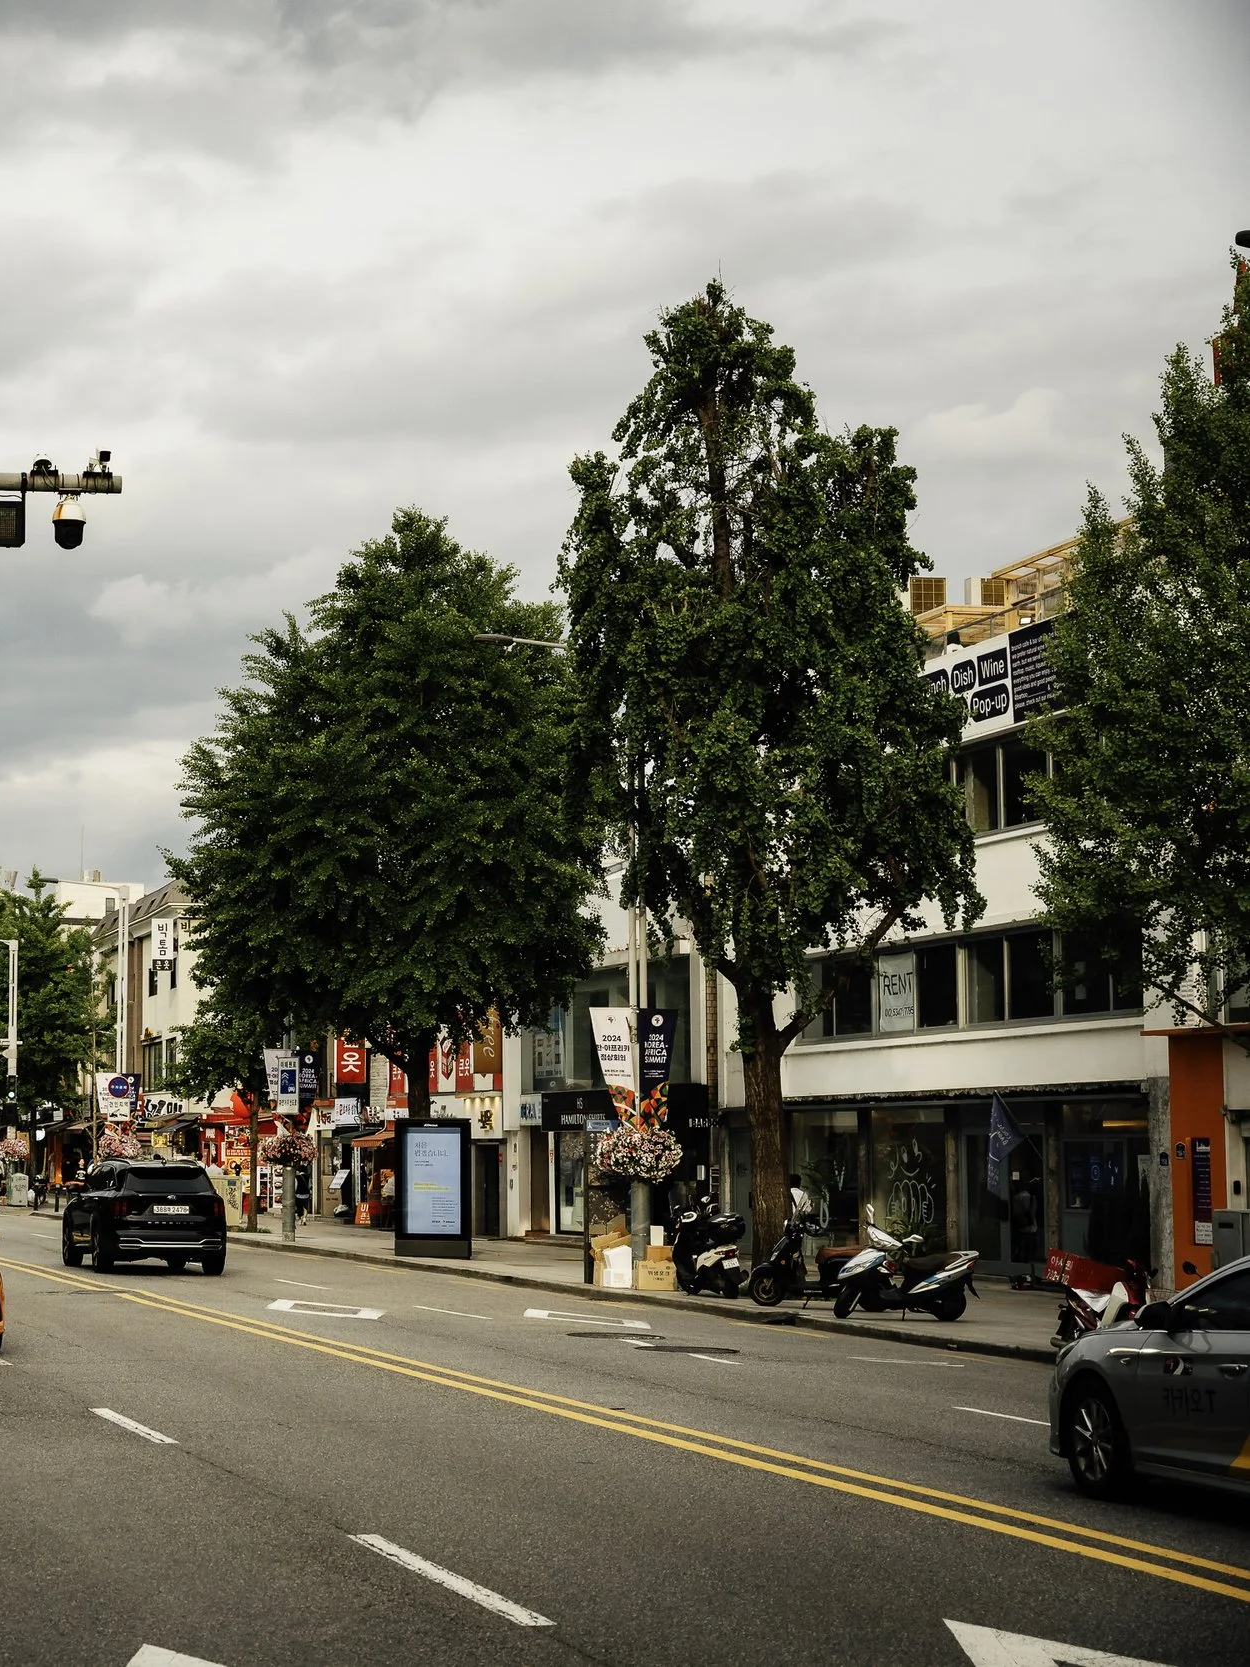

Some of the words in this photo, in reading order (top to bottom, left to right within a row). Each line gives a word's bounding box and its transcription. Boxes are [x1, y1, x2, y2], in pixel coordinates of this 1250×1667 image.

[953, 666, 974, 689] Dish
[980, 658, 1005, 679] Wine
[972, 693, 1007, 717] Pop-up
[157, 923, 168, 956] 빅톰
[883, 971, 913, 996] RENT
[602, 1034, 622, 1042] 2024
[560, 1113, 587, 1125] HAMILTON
